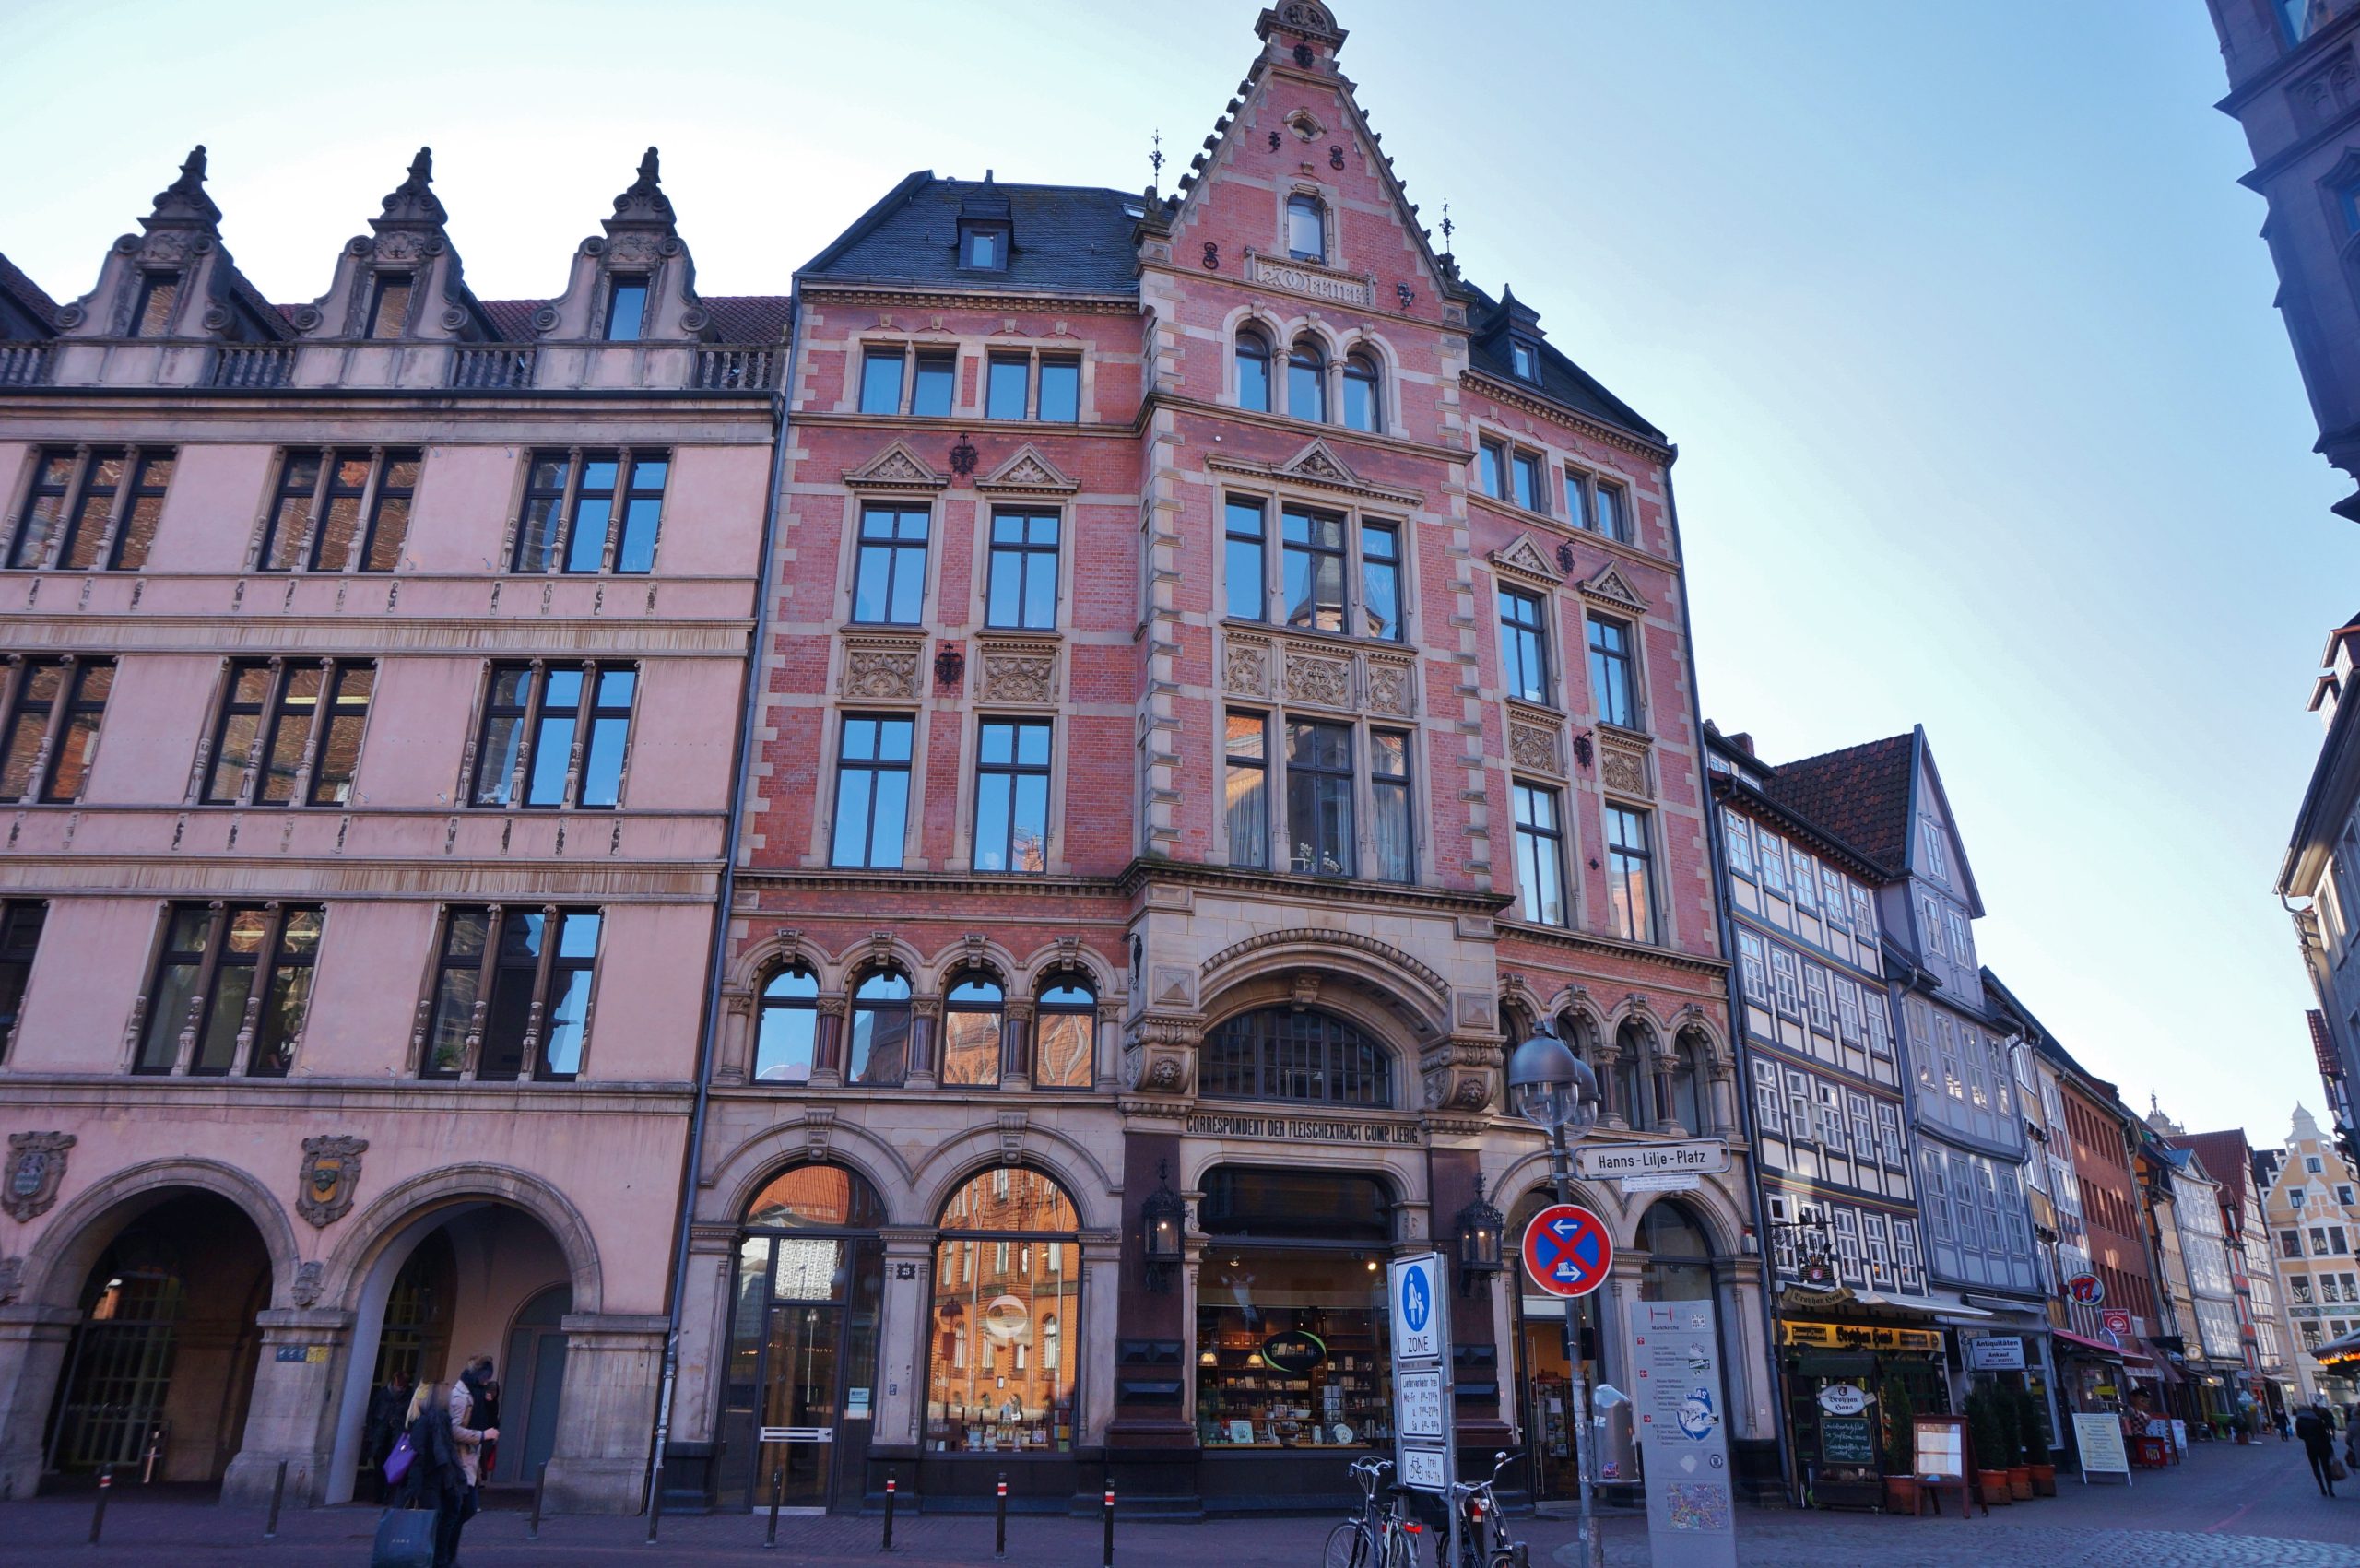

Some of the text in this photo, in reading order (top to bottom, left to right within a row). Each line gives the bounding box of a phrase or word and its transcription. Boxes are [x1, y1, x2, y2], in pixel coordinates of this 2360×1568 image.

[1186, 1115, 1265, 1136] CORRESPONDENT
[1268, 1120, 1284, 1137] DER
[1289, 1121, 1362, 1141] FLEISCHEXTRACT
[1408, 1336, 1429, 1352] ZONE
[1403, 1376, 1428, 1388] Lieferverkehr
[1428, 1456, 1436, 1468] frei
